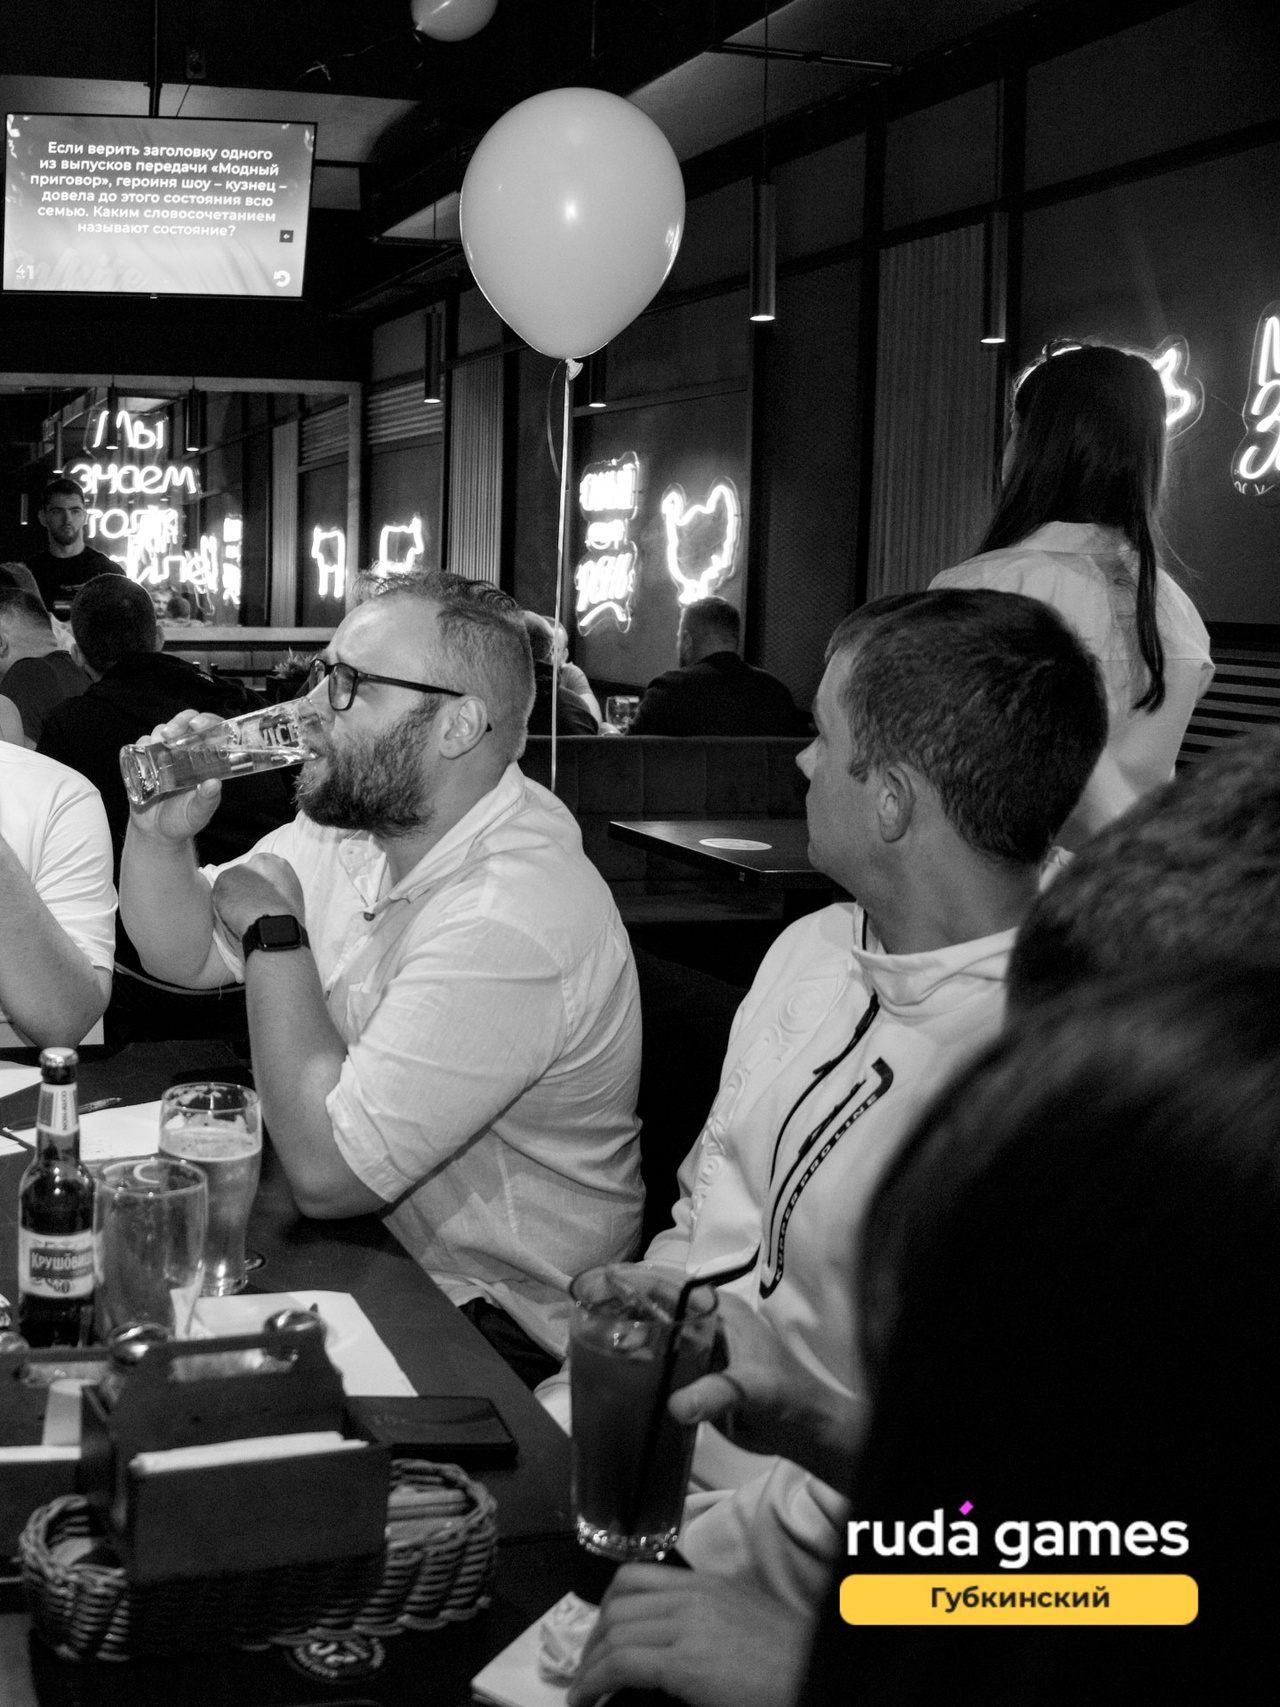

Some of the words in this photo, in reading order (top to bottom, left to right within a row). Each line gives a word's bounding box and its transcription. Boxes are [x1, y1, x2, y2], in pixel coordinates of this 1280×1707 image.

[49, 141, 83, 154] Если
[88, 144, 139, 156] верить
[144, 146, 216, 159] заголовку
[221, 148, 272, 159] одного
[39, 159, 56, 169] из
[61, 159, 131, 173] выпусков
[136, 162, 207, 175] передачи
[212, 163, 278, 176] «Модный
[116, 177, 176, 189] героиня
[182, 179, 210, 190] шоу
[226, 180, 275, 192] кузнец
[42, 191, 94, 203] довела
[99, 192, 116, 203] до
[121, 192, 159, 203] этого
[164, 193, 240, 206] состояния
[245, 196, 273, 206] всю
[38, 206, 88, 217] семью.
[94, 207, 139, 218] Каким
[144, 208, 276, 221] словосочетанием
[78, 223, 148, 234] называют
[153, 224, 235, 236] состояние?
